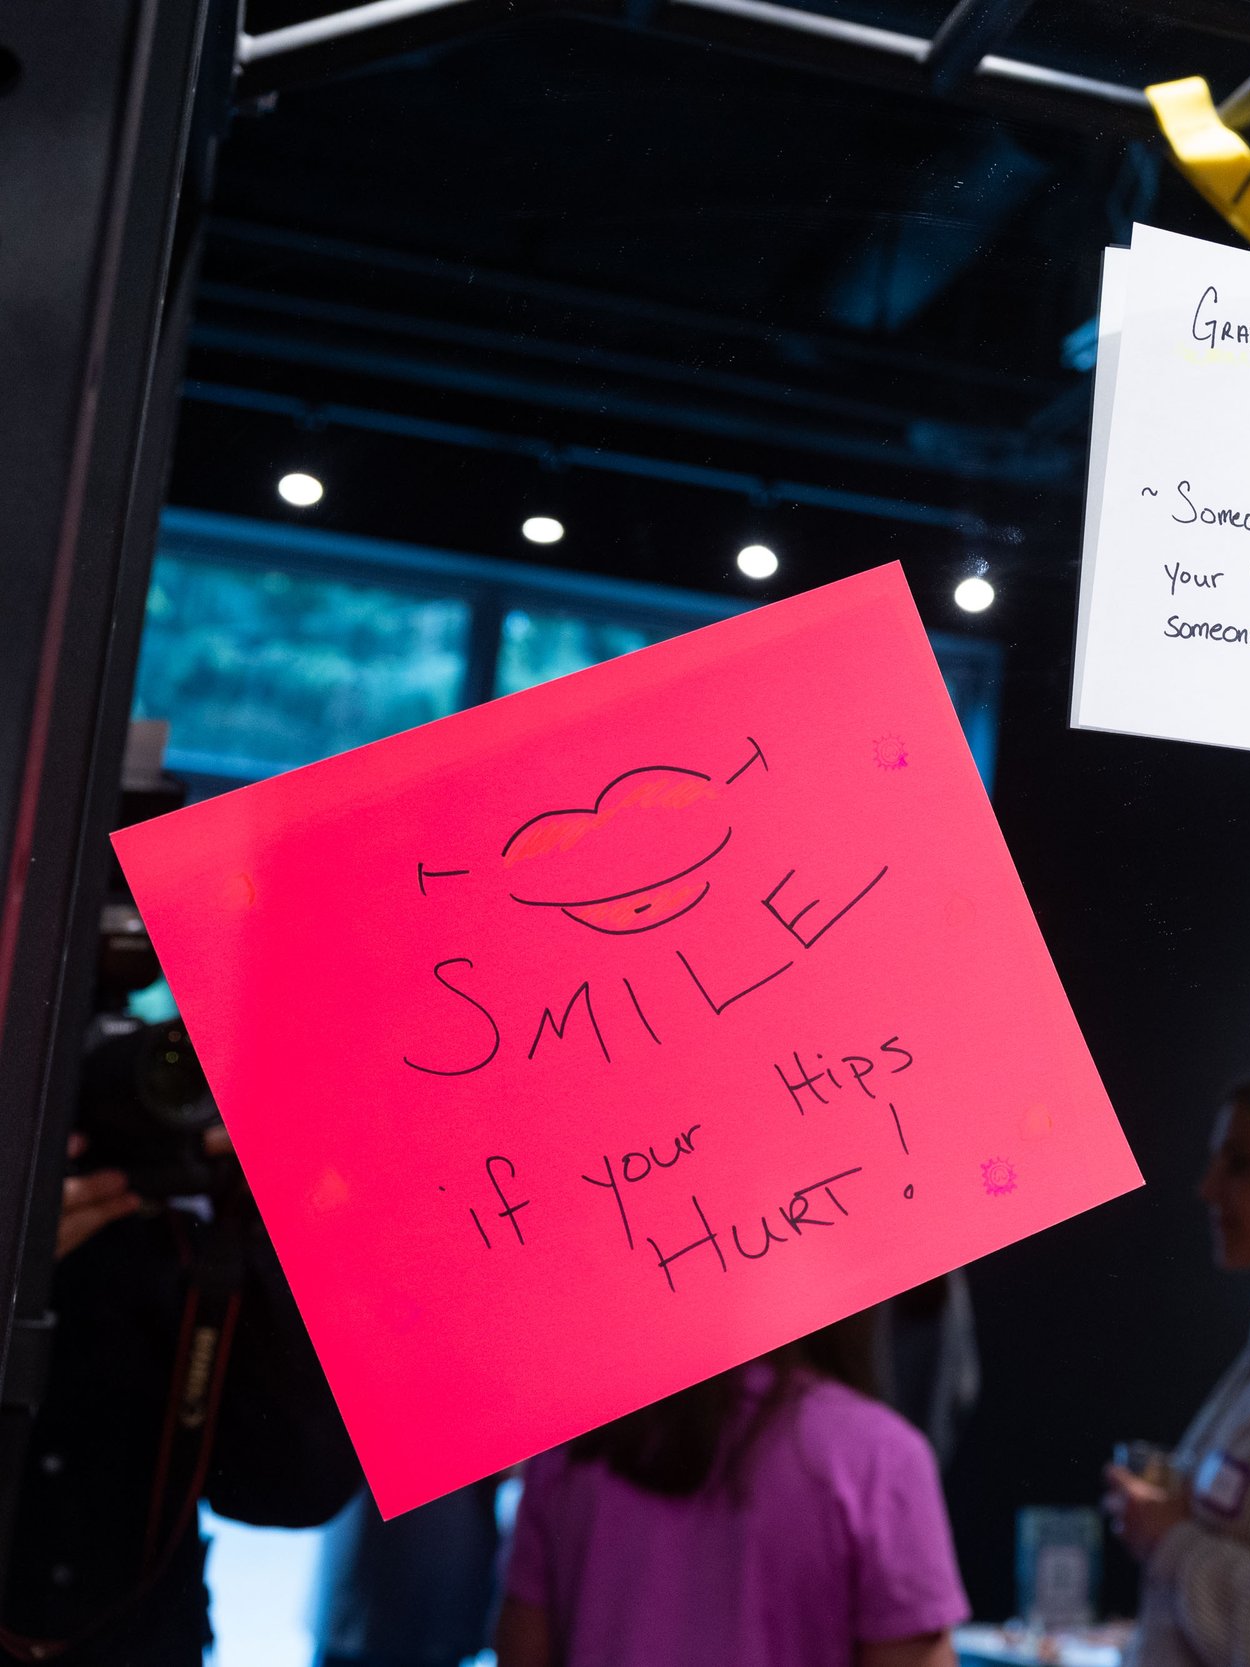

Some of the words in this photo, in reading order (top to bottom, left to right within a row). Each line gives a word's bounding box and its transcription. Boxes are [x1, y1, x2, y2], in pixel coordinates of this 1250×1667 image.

[1164, 561, 1225, 596] your
[403, 865, 889, 1077] SMILE
[438, 1155, 530, 1249] if
[581, 1124, 701, 1250] your
[773, 1036, 914, 1117] Hips
